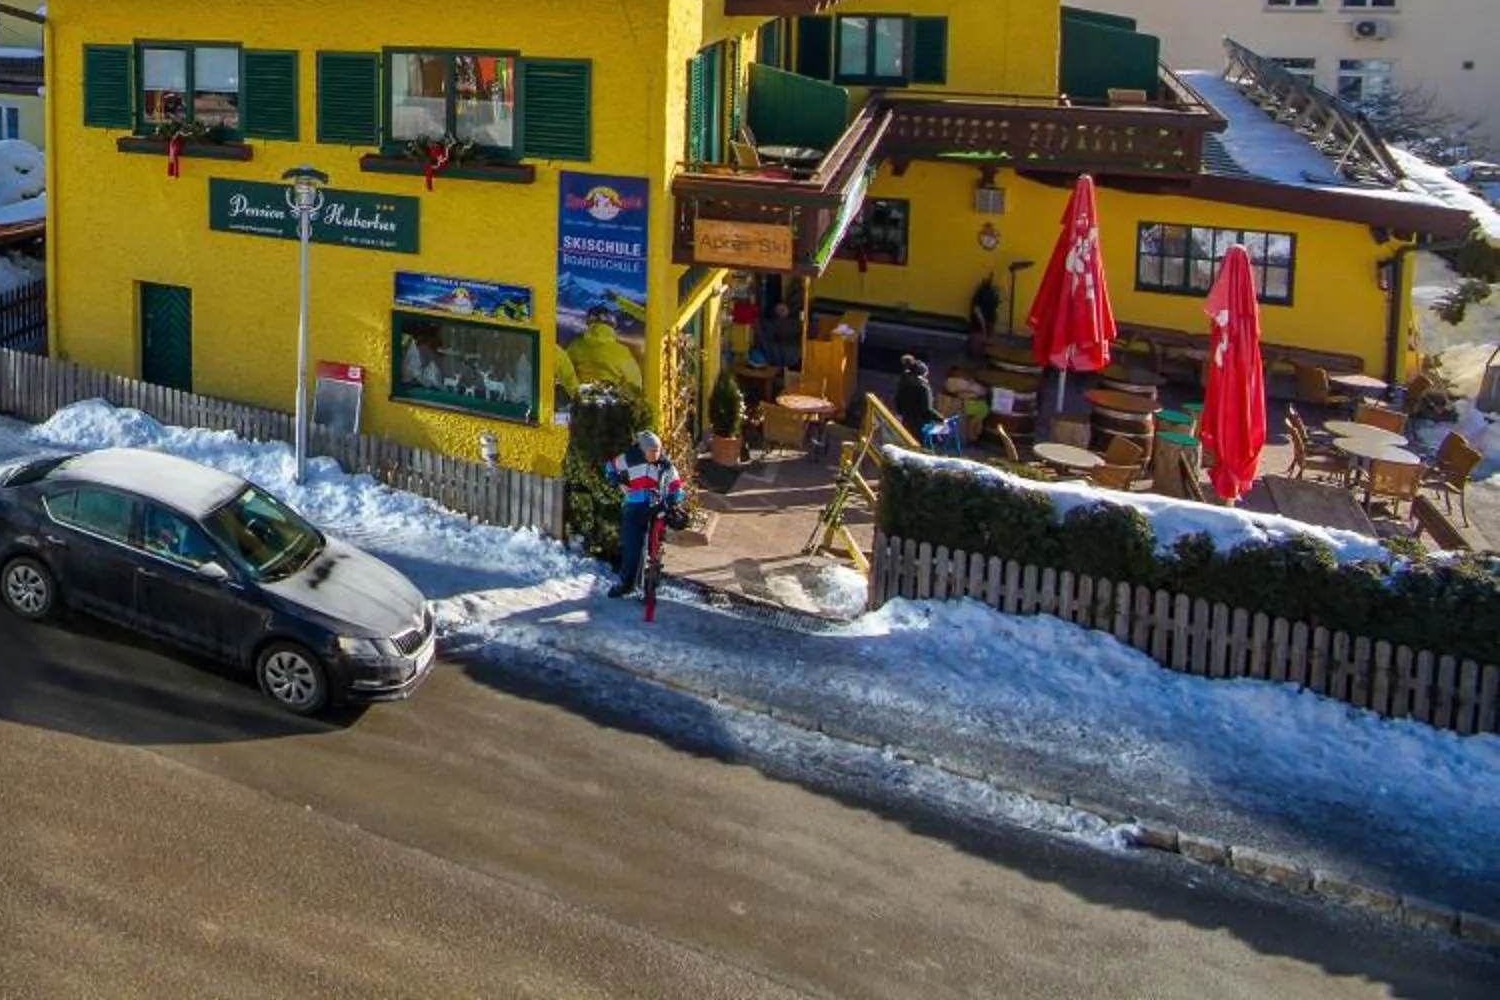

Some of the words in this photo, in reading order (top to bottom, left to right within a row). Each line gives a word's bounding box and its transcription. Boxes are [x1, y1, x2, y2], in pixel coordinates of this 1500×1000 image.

[228, 193, 285, 220] Pension
[323, 203, 397, 232] Hubertus
[563, 235, 642, 257] SKISCHULE
